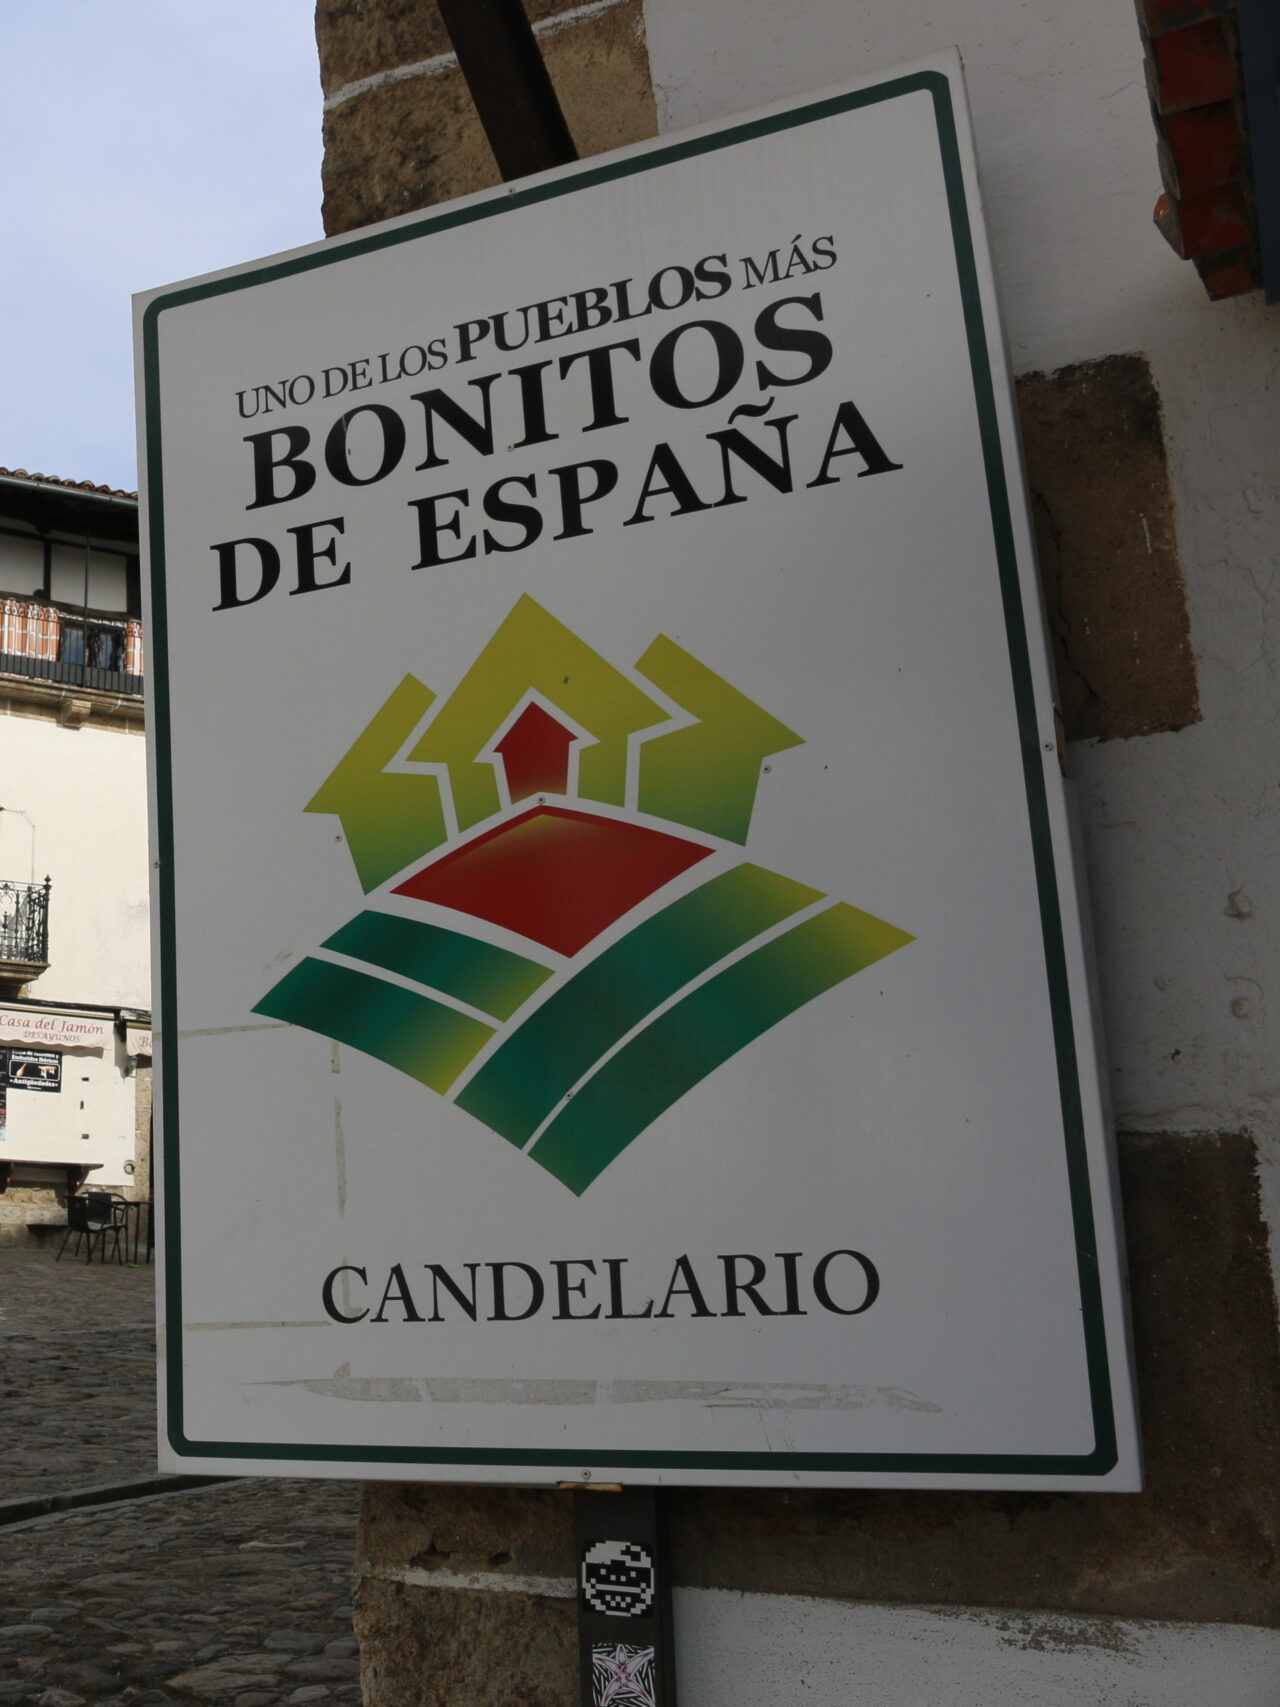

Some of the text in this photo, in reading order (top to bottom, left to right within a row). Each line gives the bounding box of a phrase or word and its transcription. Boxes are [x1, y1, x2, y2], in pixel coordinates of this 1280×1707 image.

[235, 234, 838, 419] UNO DE LOS PUEBLOS MÁS
[243, 291, 835, 511] BONITOS
[209, 396, 904, 612] DE ESPAÑA
[23, 1030, 81, 1043] DESAYUNOS
[35, 1016, 55, 1031] del
[59, 1020, 105, 1036] Jamón
[321, 1248, 880, 1324] CANDELARIO
